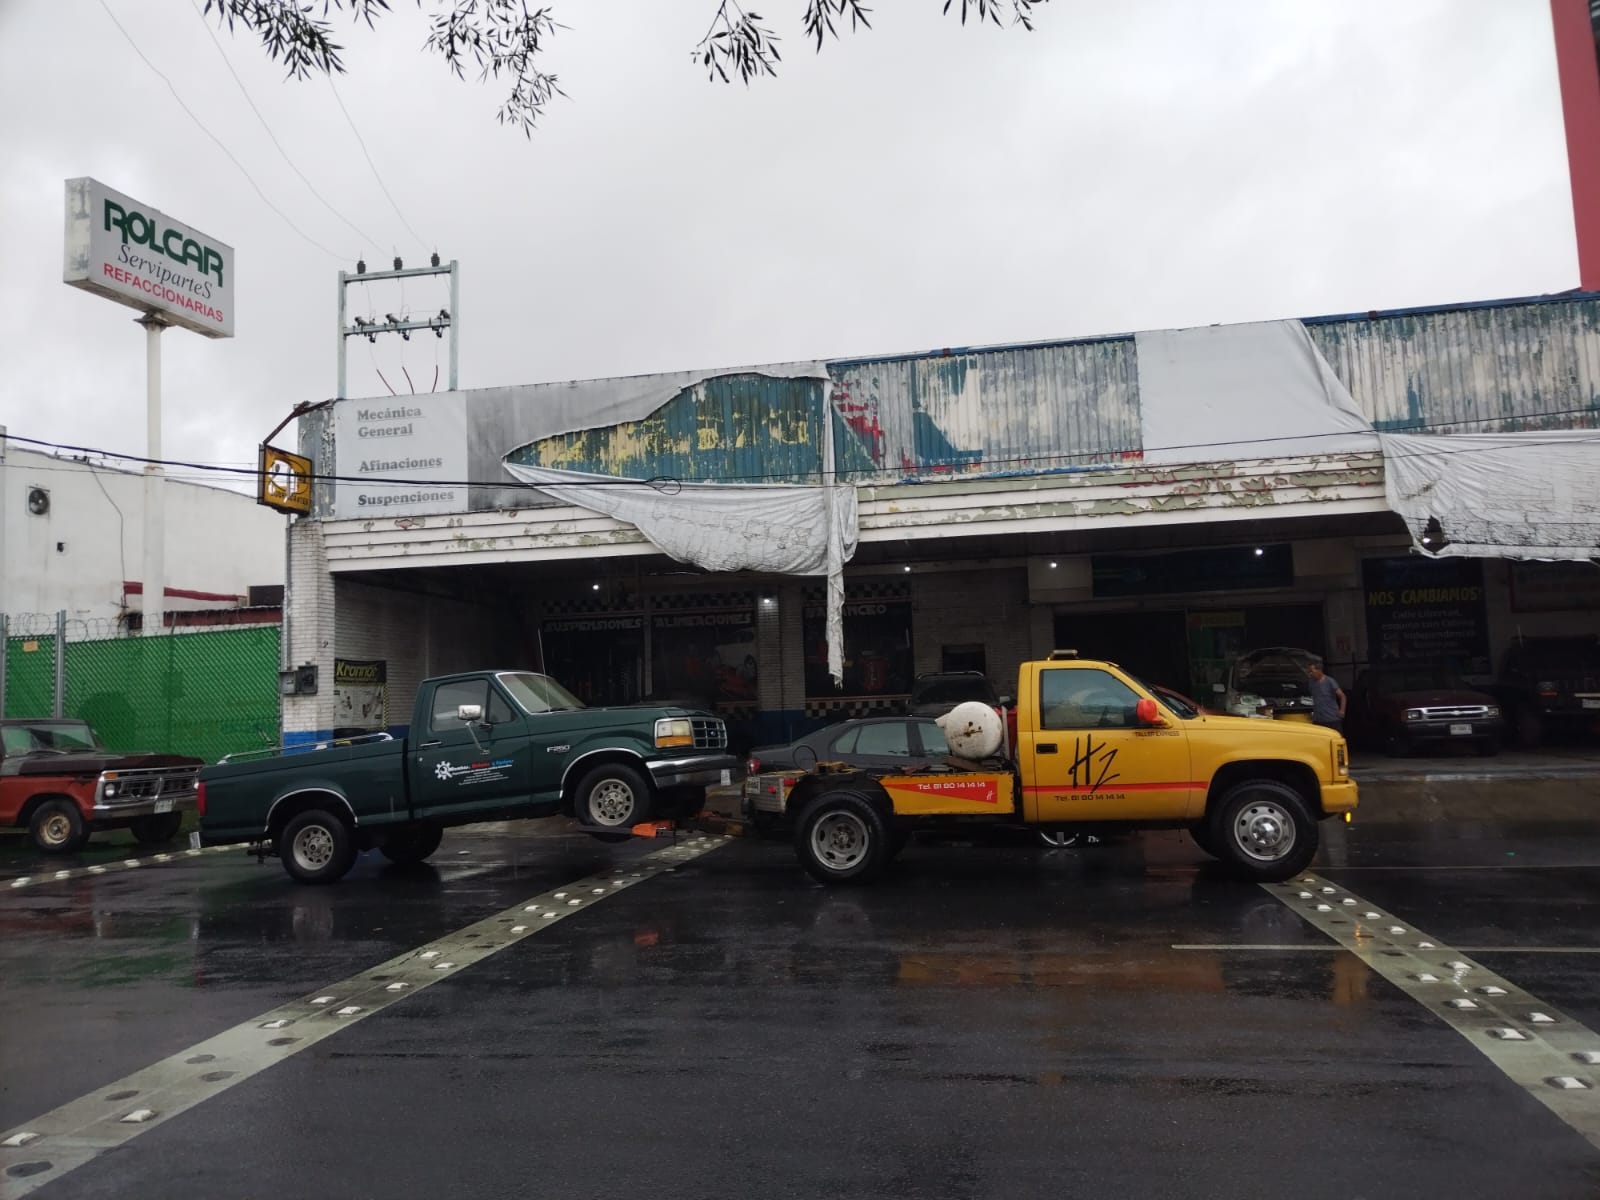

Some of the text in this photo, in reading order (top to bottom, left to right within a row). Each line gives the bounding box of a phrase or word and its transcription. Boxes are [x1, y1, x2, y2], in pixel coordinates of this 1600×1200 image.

[104, 198, 223, 288] ROLCAR
[118, 244, 213, 299] ServiparteS
[103, 262, 223, 322] REFACCIONARIAS
[358, 406, 422, 421] Mecánica
[358, 423, 414, 438] General
[359, 457, 443, 472] Afinaciones
[358, 490, 455, 506] Suspenciones
[1368, 591, 1395, 606] NOS
